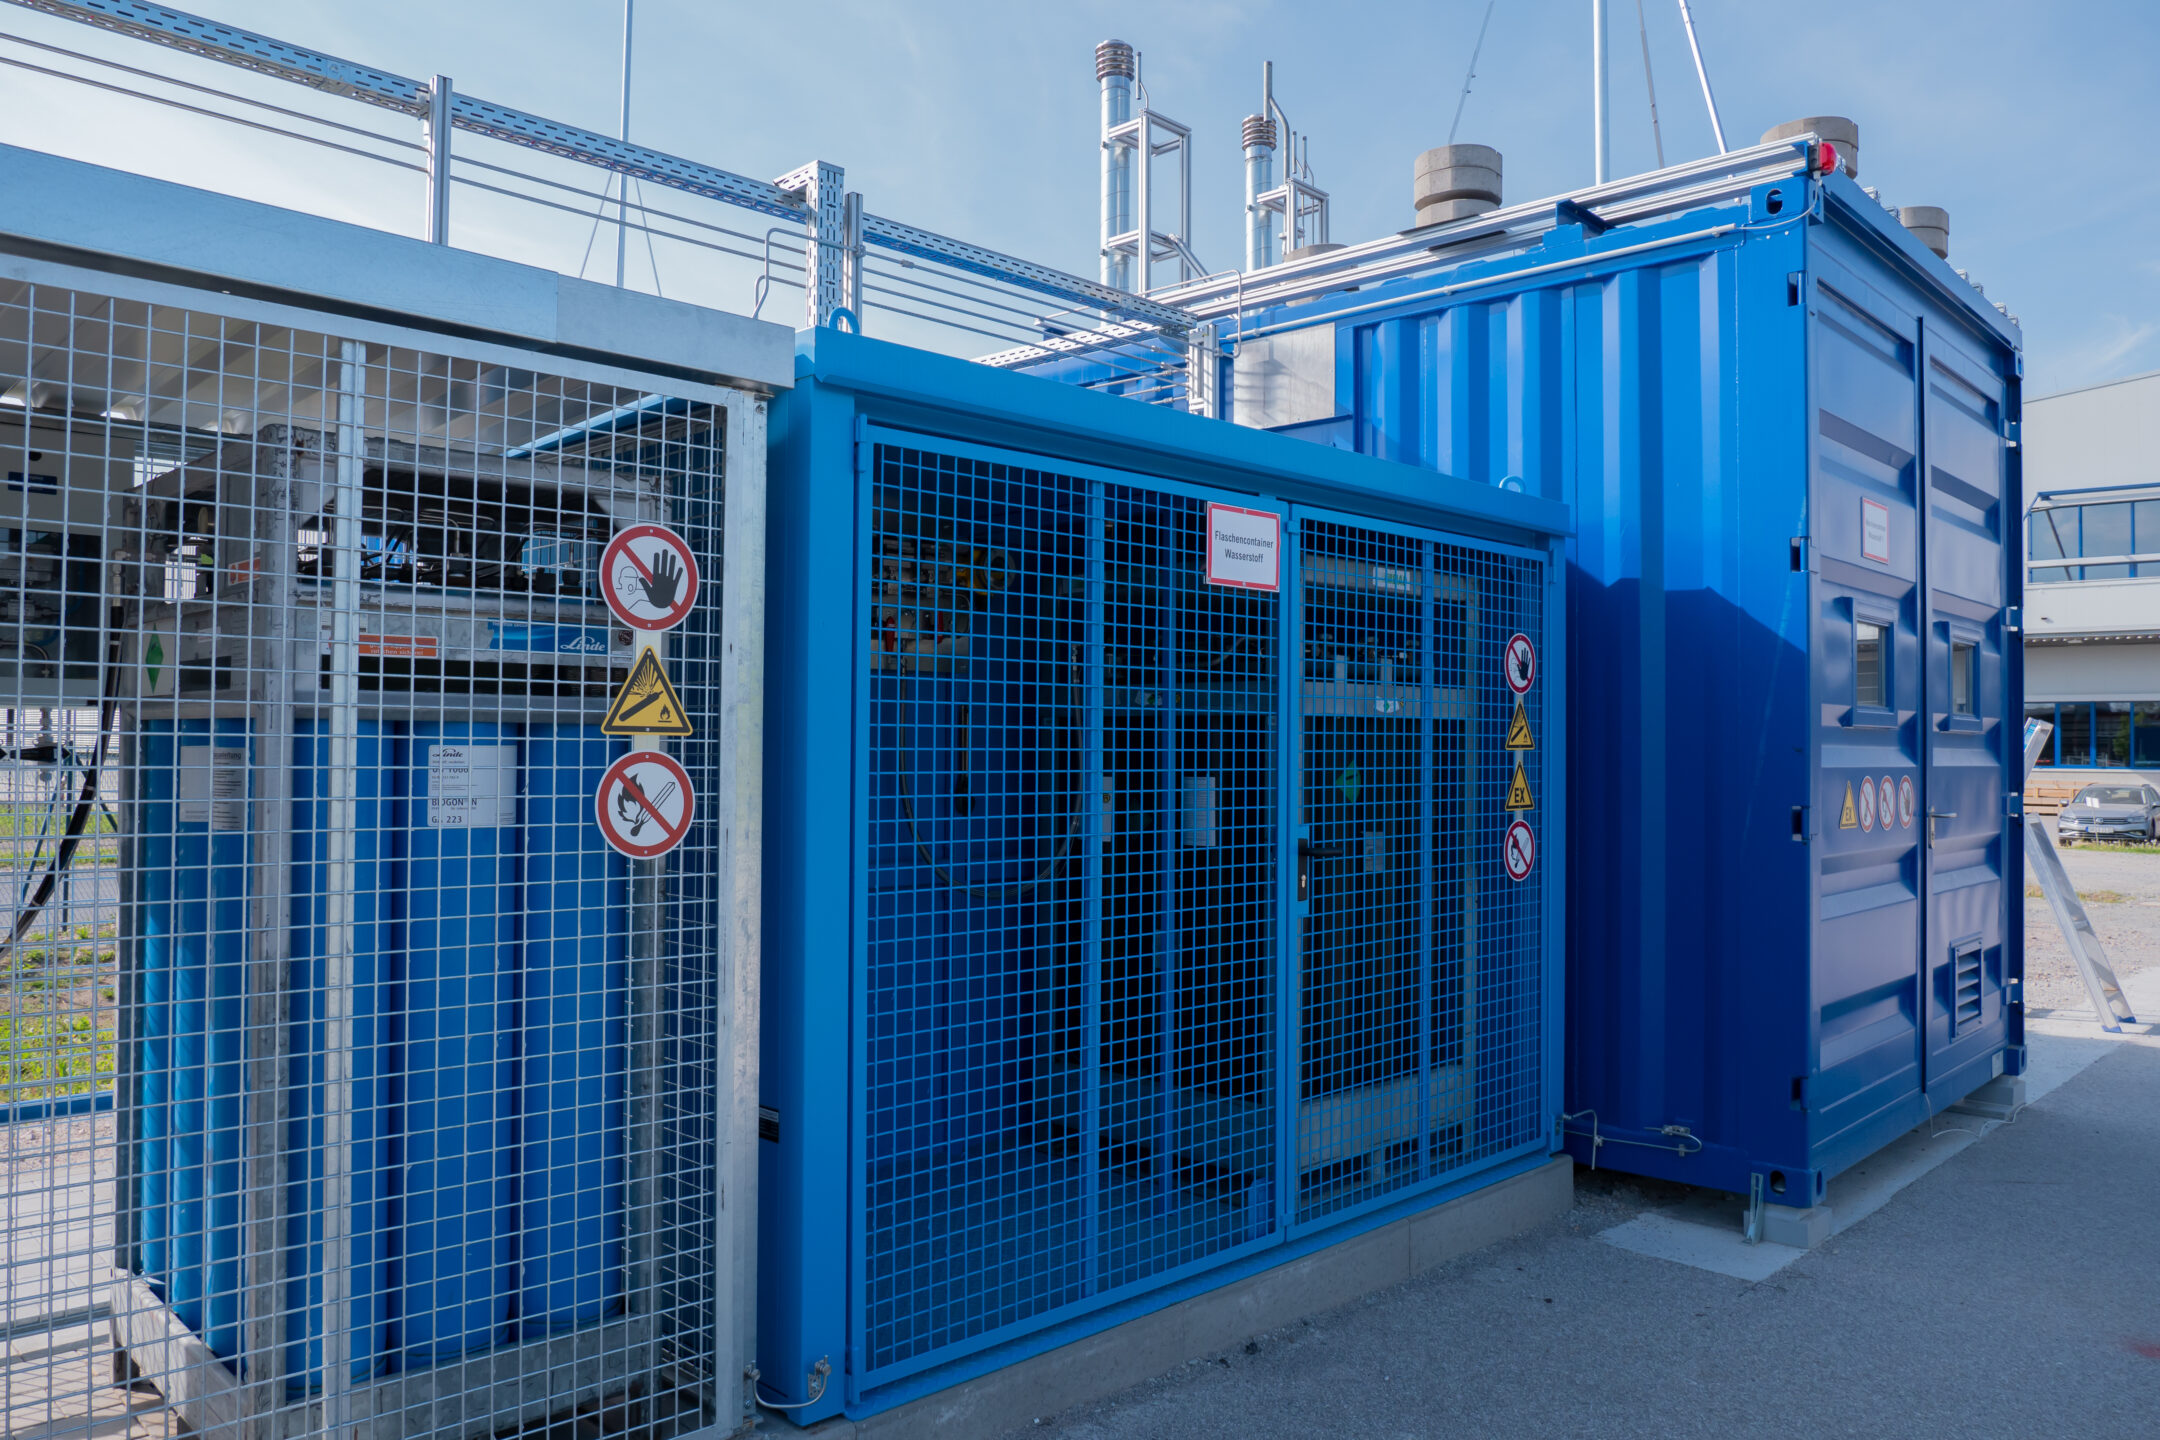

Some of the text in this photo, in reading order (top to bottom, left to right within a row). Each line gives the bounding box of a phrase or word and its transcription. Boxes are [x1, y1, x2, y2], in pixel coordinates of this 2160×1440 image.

[1215, 530, 1273, 549] Flaschencontainer
[1225, 548, 1264, 563] Wasserstoff
[560, 636, 606, 652] Linde
[1514, 787, 1525, 803] EX
[446, 815, 462, 824] 223
